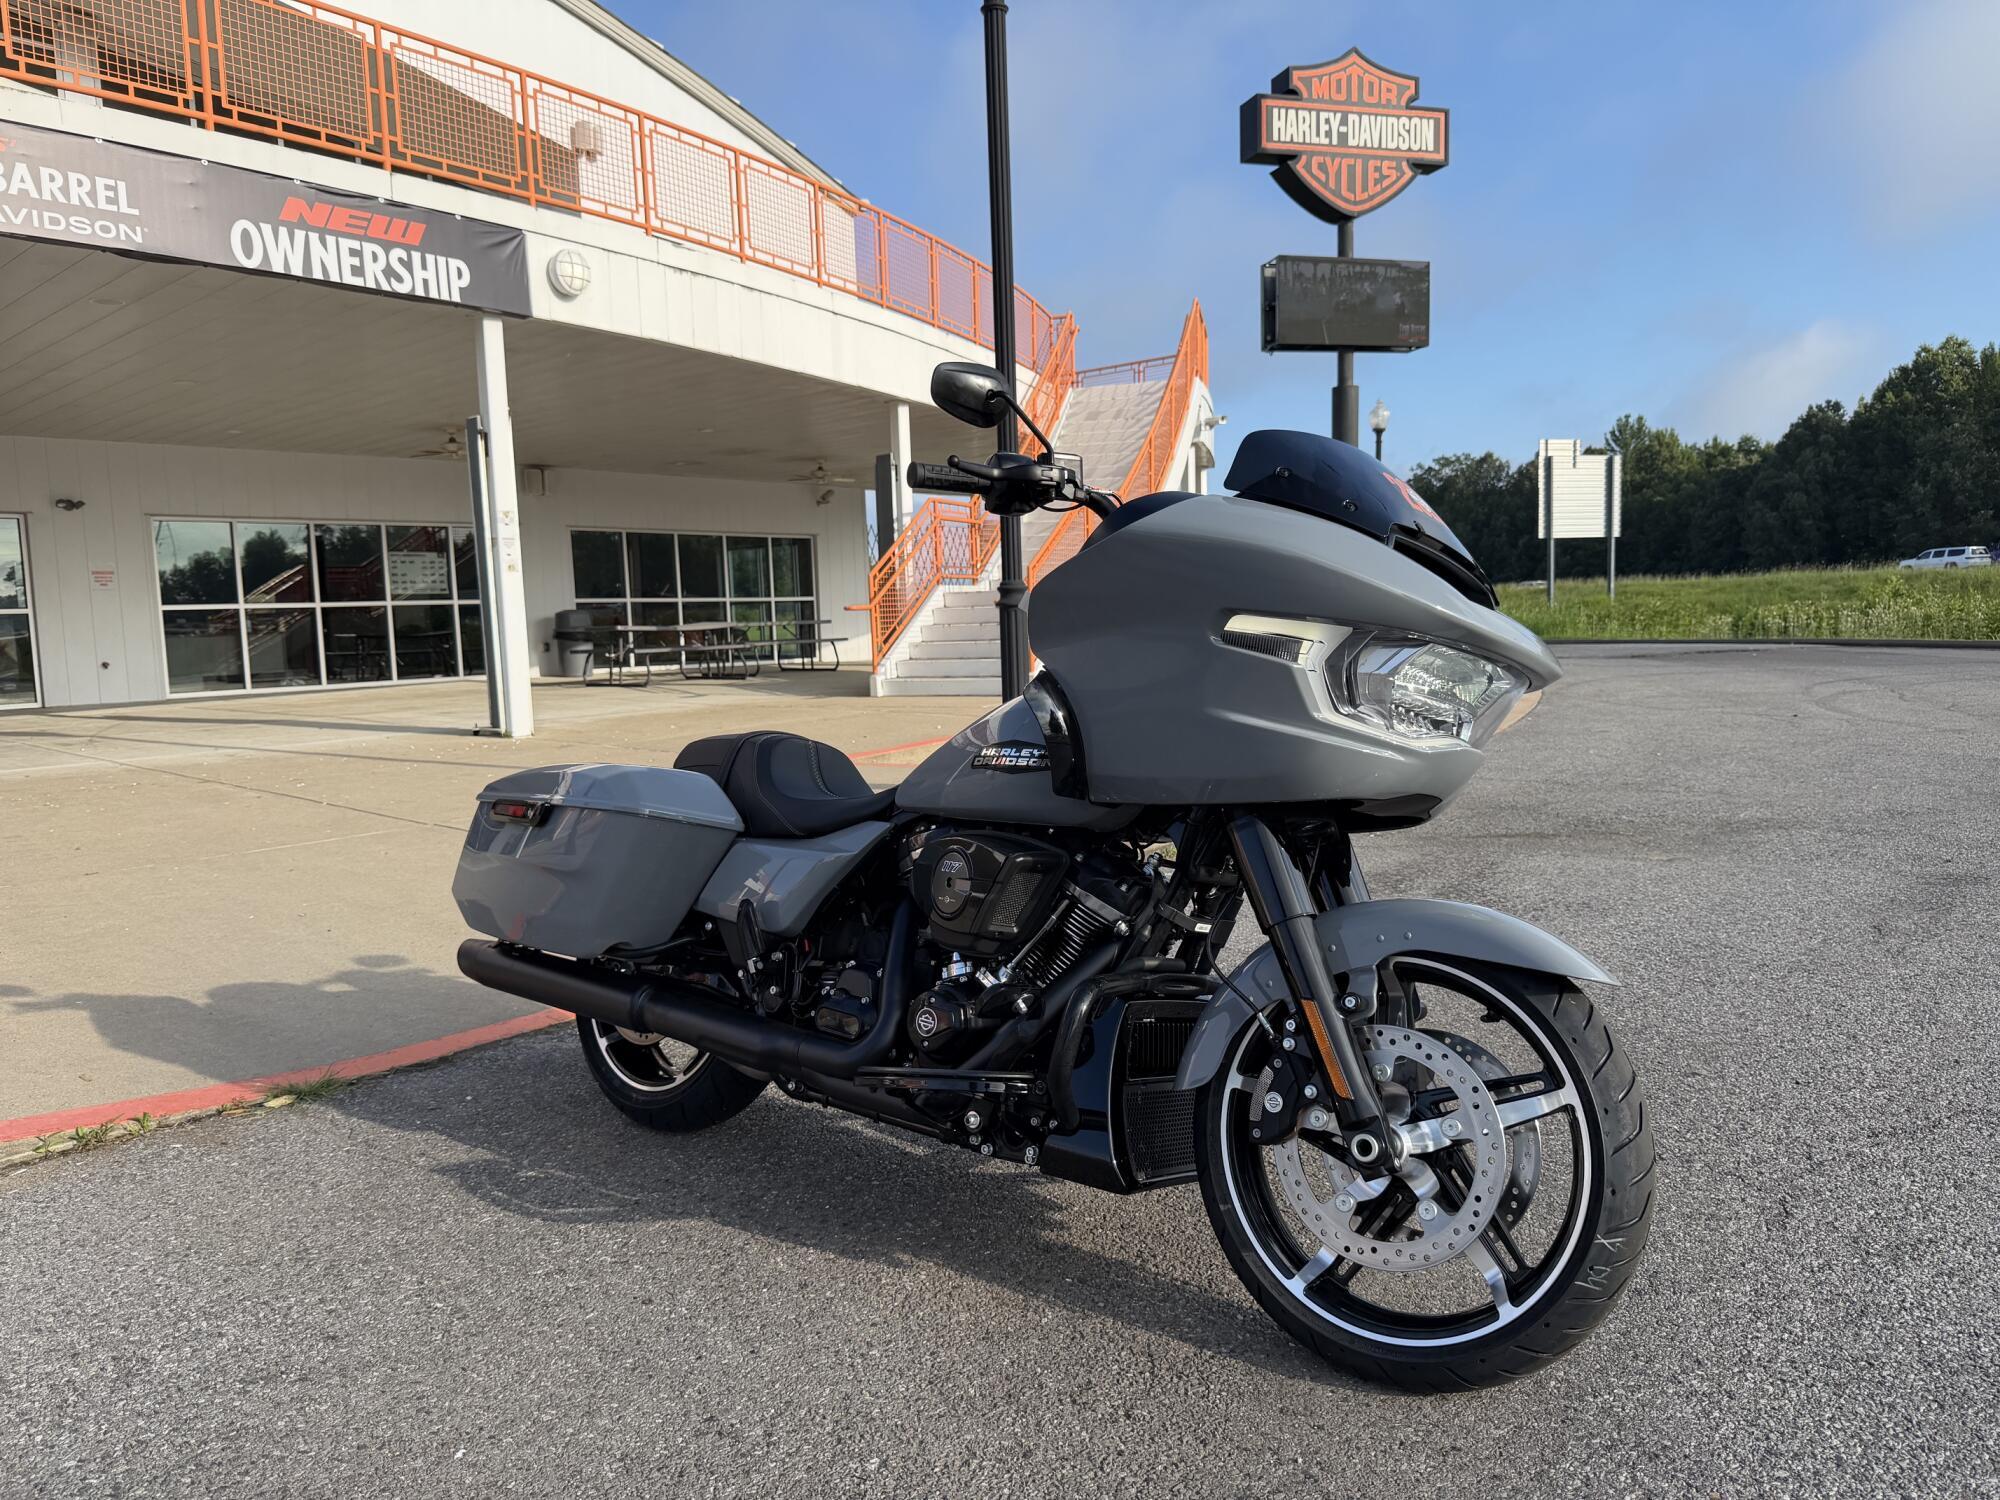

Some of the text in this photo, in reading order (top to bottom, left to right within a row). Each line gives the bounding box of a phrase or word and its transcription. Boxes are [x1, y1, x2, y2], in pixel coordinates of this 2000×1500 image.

[1312, 65, 1397, 105] MOTOR
[1272, 107, 1435, 152] HARLEY-DAVIDSON
[1311, 155, 1396, 201] CYCLES
[278, 196, 427, 247] NEW
[230, 218, 471, 303] OWNERSHIP
[941, 860, 963, 873] 117
